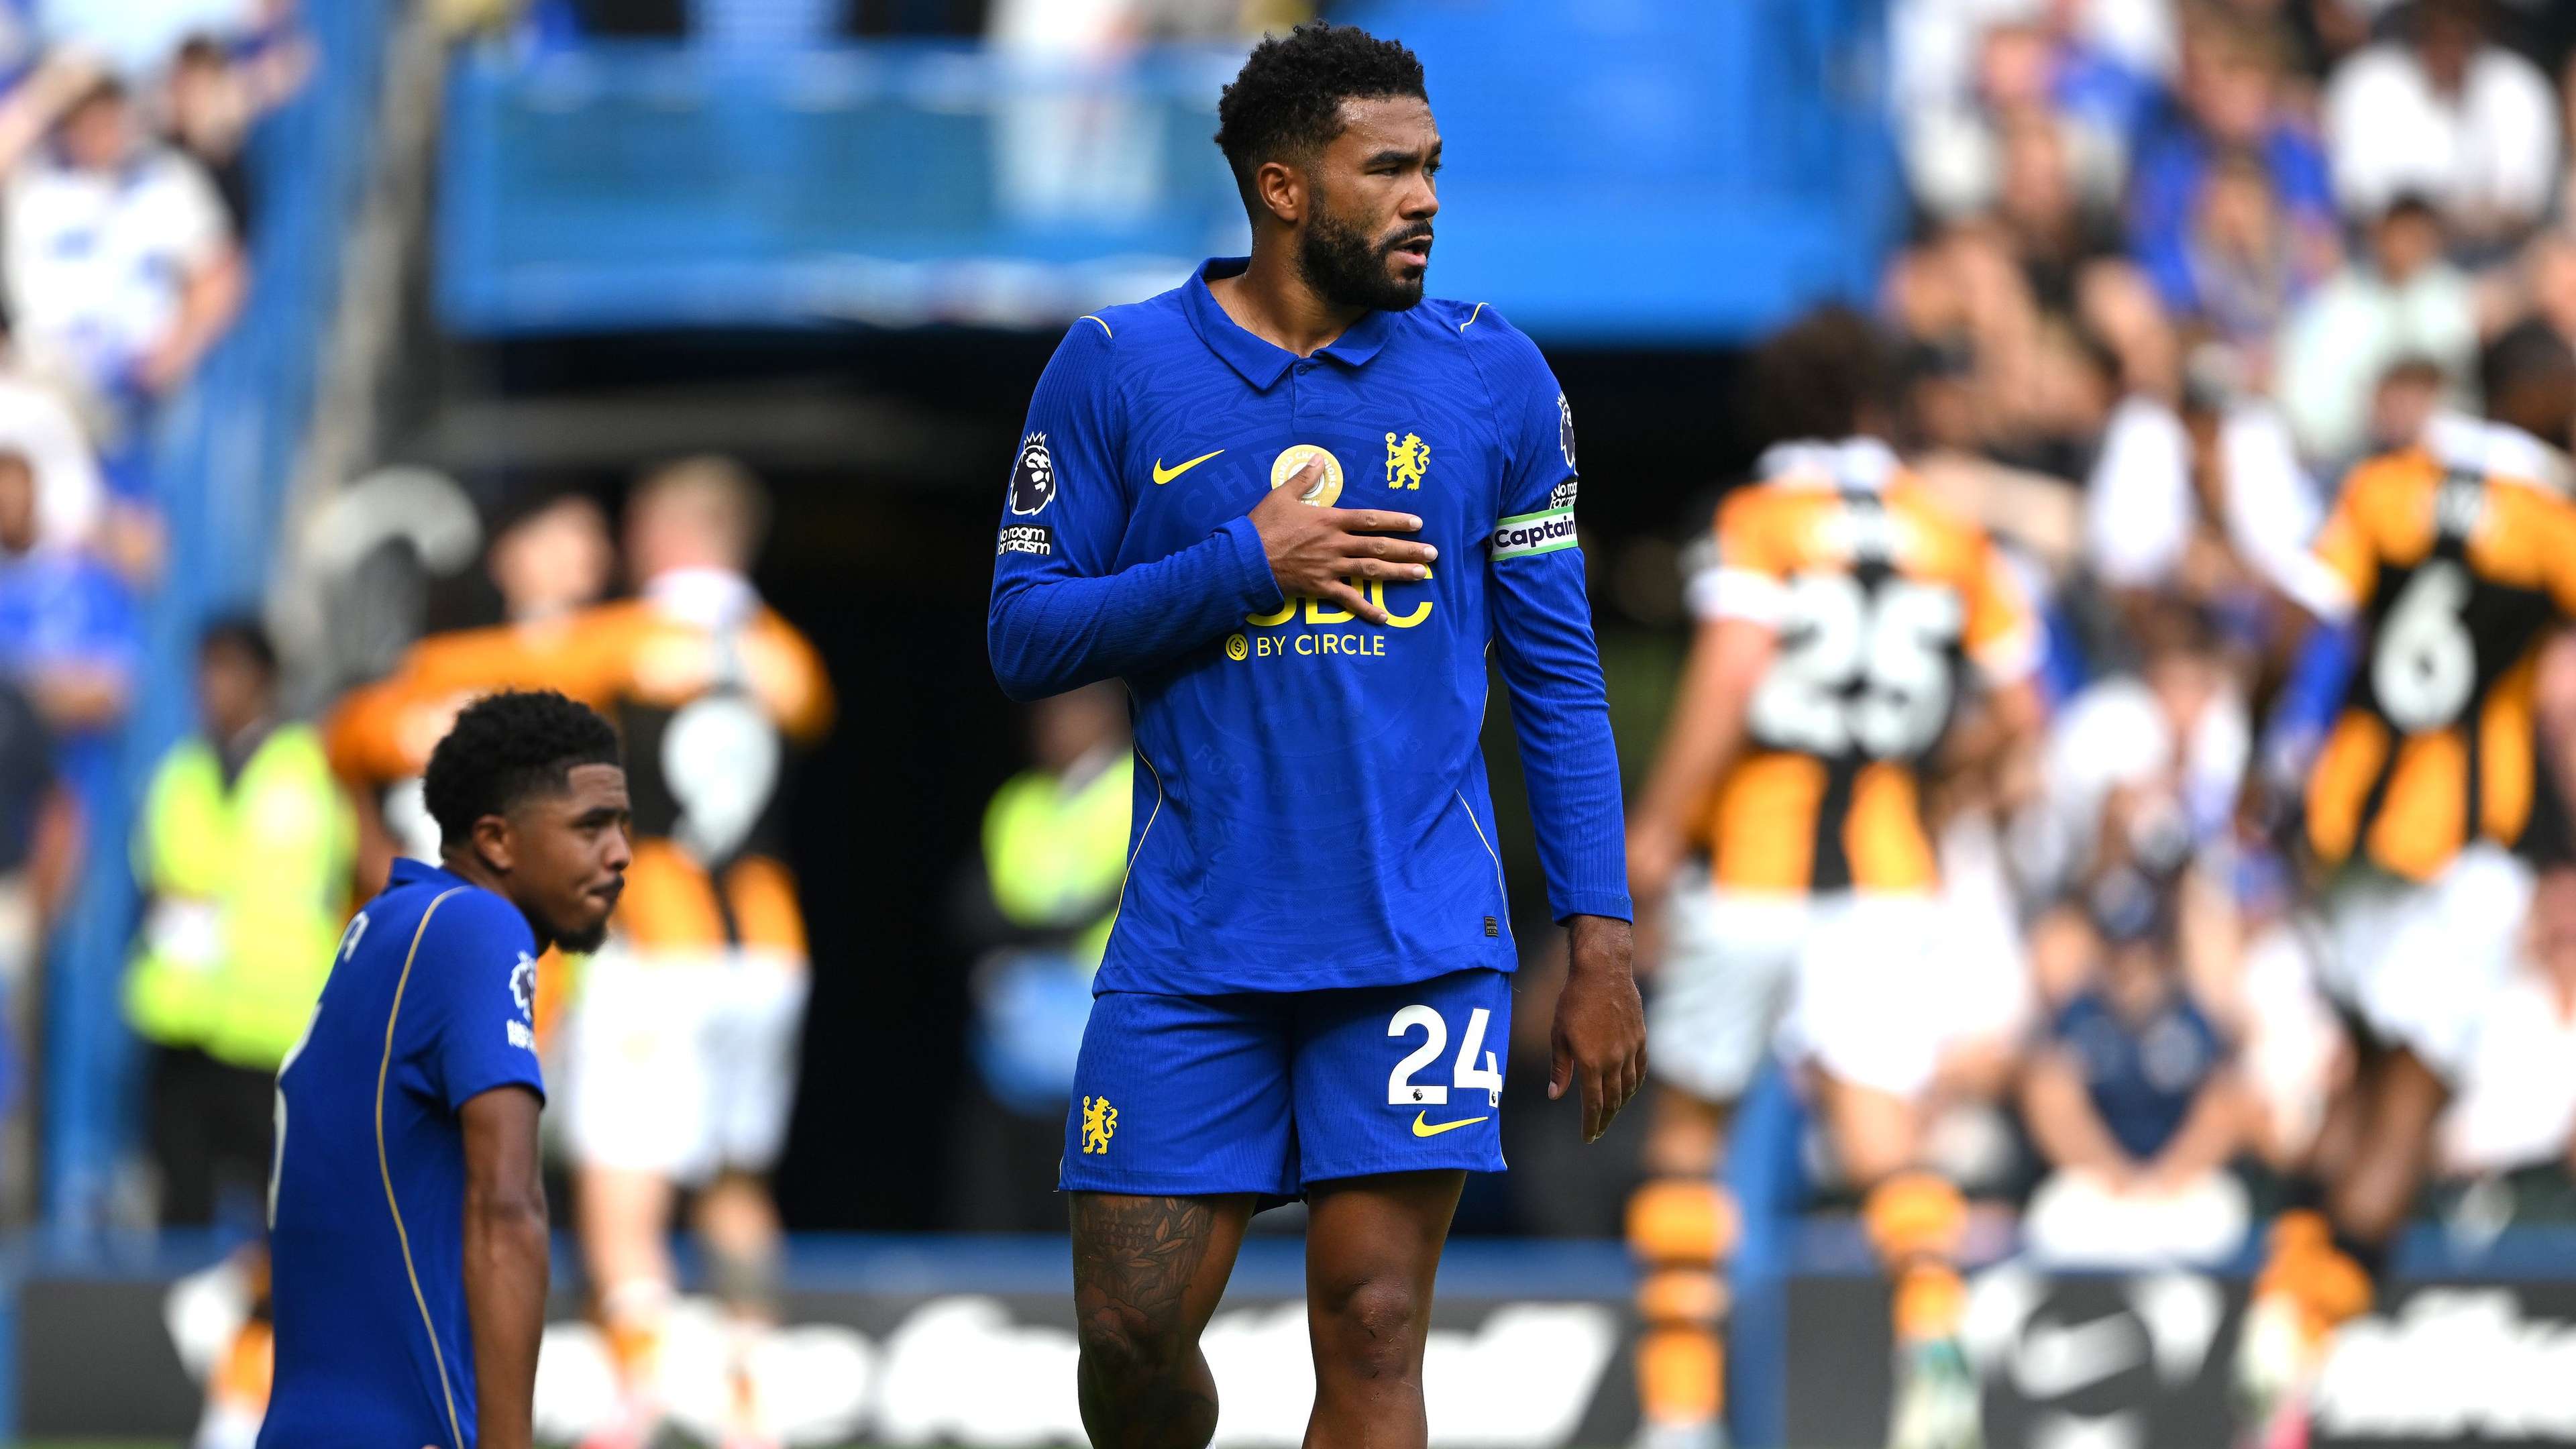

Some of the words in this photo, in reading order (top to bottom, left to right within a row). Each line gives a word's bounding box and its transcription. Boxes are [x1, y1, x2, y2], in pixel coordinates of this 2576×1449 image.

[1008, 527, 1045, 541] room
[1494, 515, 1576, 548] Captain
[1006, 539, 1051, 555] racism
[1256, 636, 1286, 657] BY
[1295, 634, 1385, 656] CIRCLE
[2373, 560, 2477, 733] 6
[1387, 1004, 1503, 1108] 24
